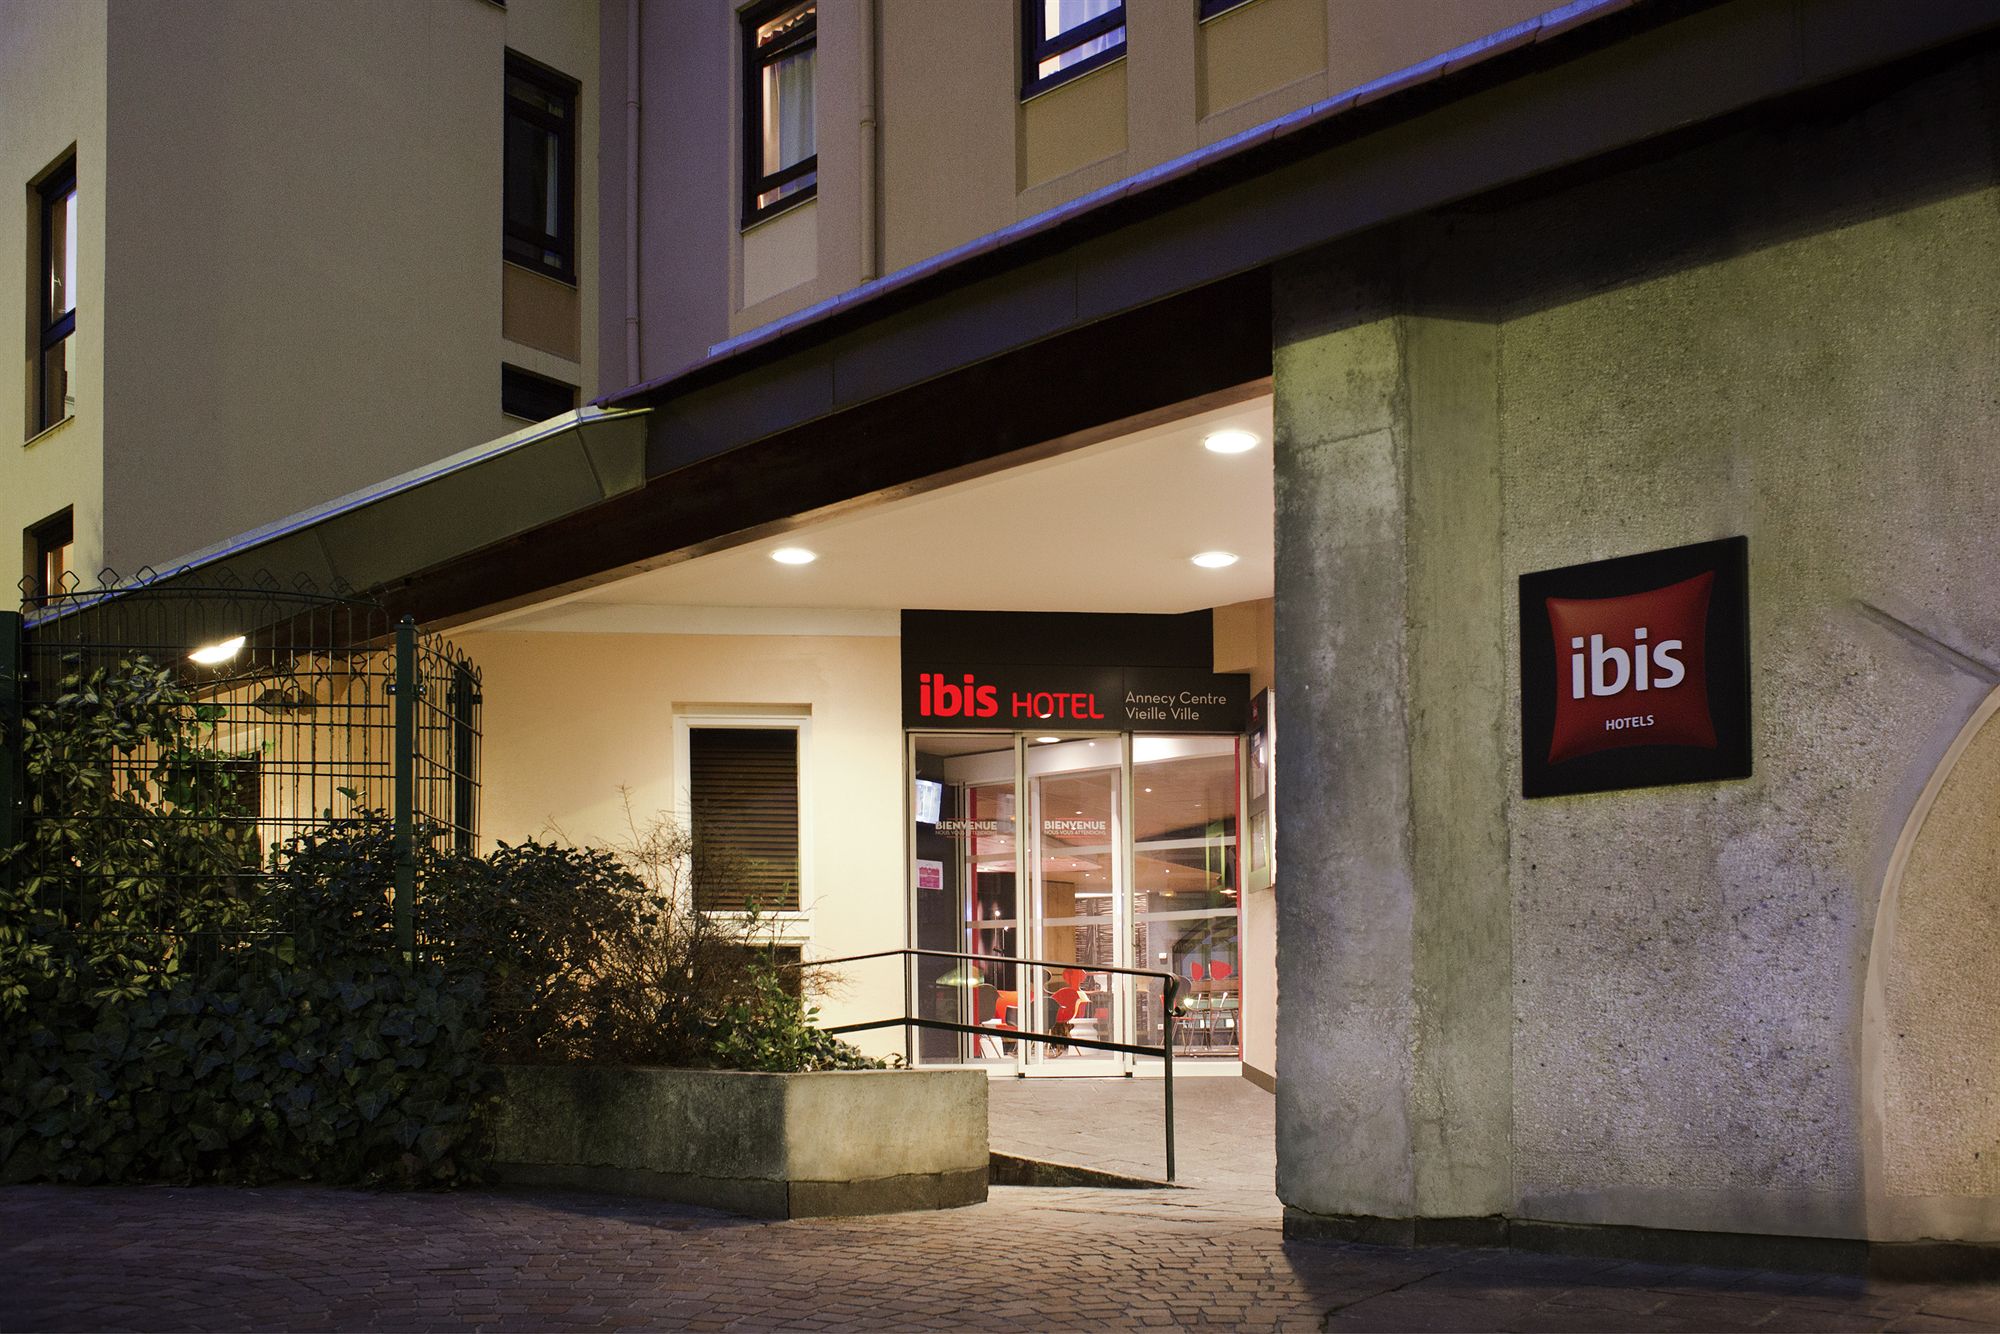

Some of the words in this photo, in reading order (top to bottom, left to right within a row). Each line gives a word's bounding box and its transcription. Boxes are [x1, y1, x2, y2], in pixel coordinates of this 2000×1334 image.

[1571, 627, 1686, 699] ibis
[919, 673, 999, 718] ibis
[1012, 692, 1105, 719] HOTEL
[1125, 690, 1176, 707] Annecy
[1180, 691, 1227, 705] Centre
[1125, 706, 1167, 720] Vieille
[1170, 707, 1200, 720] Ville
[1605, 715, 1655, 731] HOTELS
[935, 821, 998, 830] BIENVENUE
[1044, 820, 1106, 830] BIENVENUE
